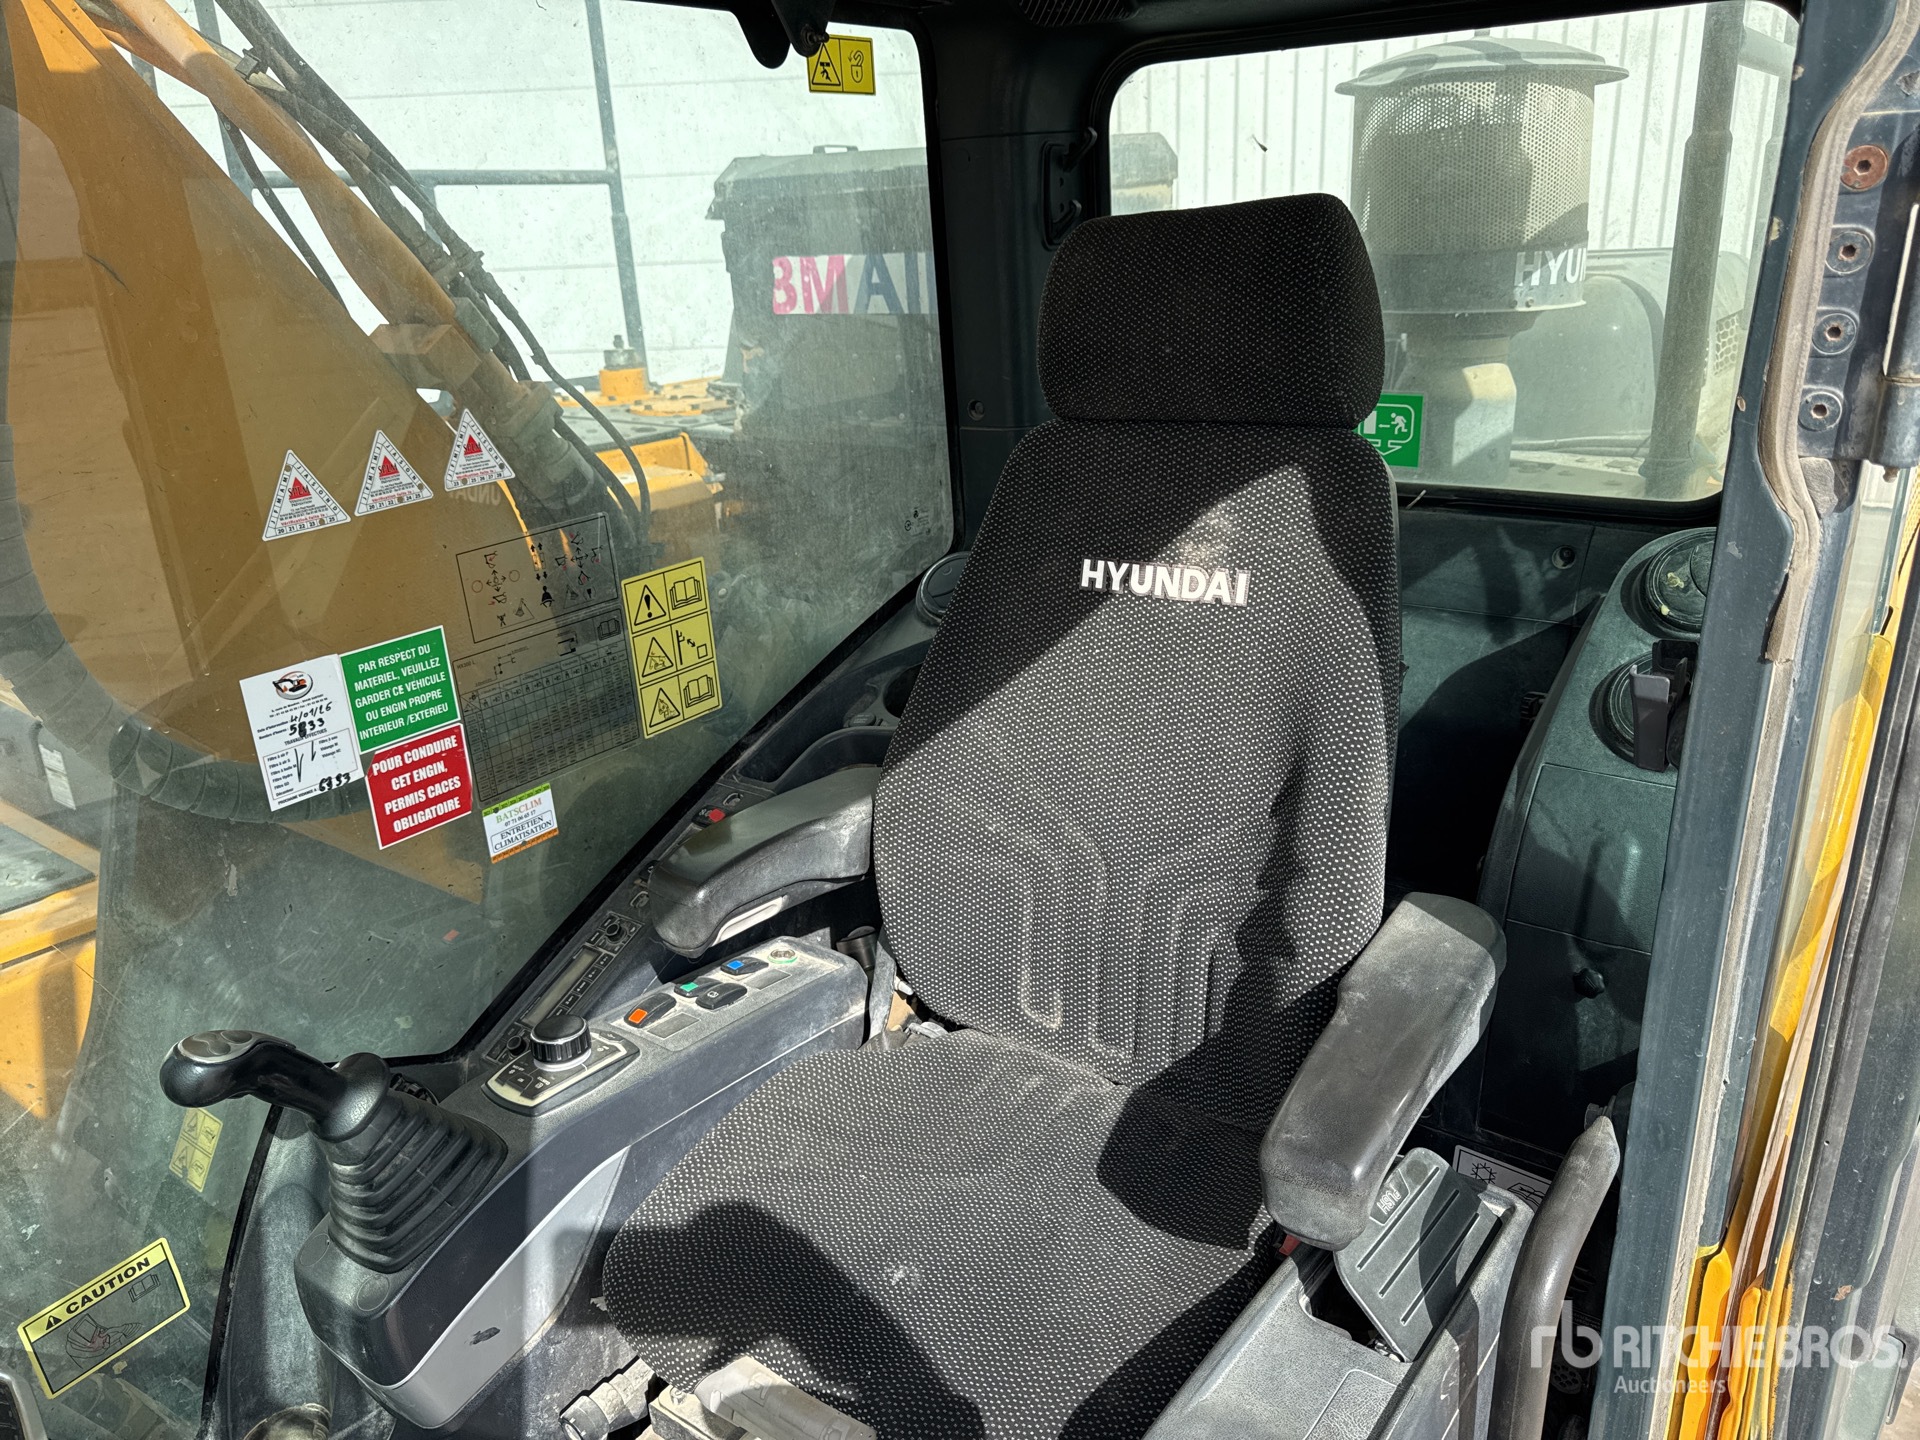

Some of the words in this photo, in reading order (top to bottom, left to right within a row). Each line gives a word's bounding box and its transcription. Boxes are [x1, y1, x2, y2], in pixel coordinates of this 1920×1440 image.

[772, 252, 938, 314] BMAI
[1080, 558, 1249, 605] HYUNDAI
[354, 671, 400, 692] MATERIEL,
[401, 657, 440, 677] VEUILLEZ
[358, 661, 376, 673] PAR
[378, 648, 416, 668] RESPECT
[418, 644, 430, 656] DU
[355, 690, 391, 708] GARDER
[392, 685, 404, 696] CE
[405, 672, 446, 692] VEHICULE
[366, 710, 378, 721] OU
[380, 700, 407, 716] ENGIN
[409, 689, 442, 707] PROPRE
[359, 718, 405, 740] INTERIEUR
[372, 755, 403, 776] POUR
[404, 735, 458, 764] CONDUIRE
[391, 773, 411, 790] CET
[413, 760, 448, 782] ENGIN,
[384, 789, 426, 815] PERMIS
[427, 776, 461, 798] CACES
[496, 798, 542, 823] BATSCLIM
[393, 797, 460, 833] OBLIGATOIRE
[501, 816, 543, 839] ENTRETIEN
[494, 820, 552, 850] CLIMATISATION
[1376, 1182, 1402, 1215] PUSH
[66, 1257, 150, 1315] CAUTION
